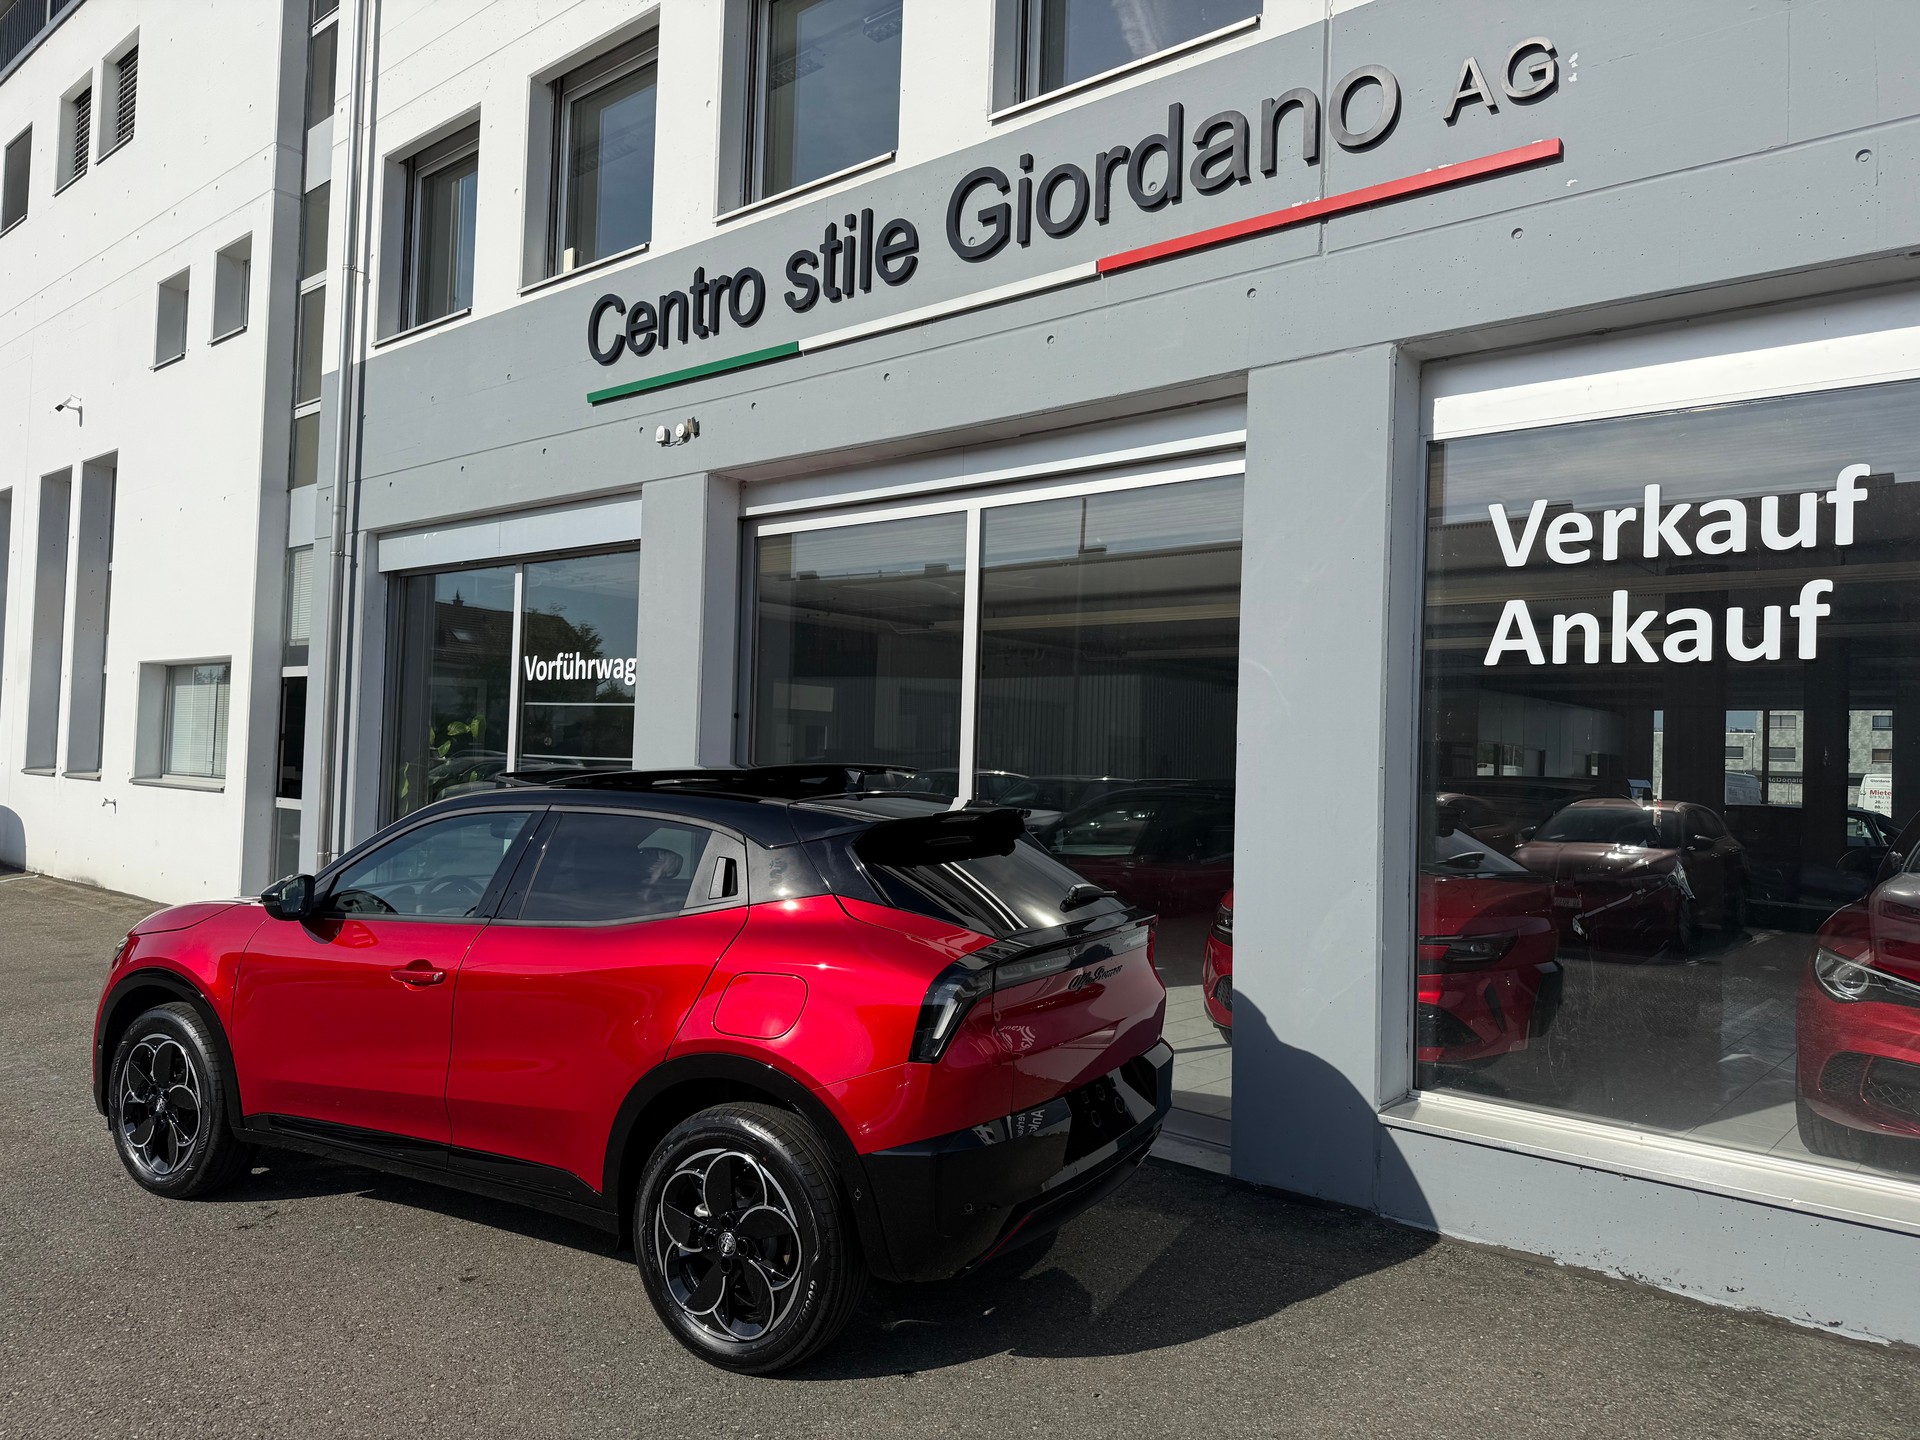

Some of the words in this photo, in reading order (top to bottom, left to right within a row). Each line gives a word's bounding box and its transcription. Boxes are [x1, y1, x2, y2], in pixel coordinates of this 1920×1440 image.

[587, 266, 766, 366] Centro
[783, 207, 920, 314] stile
[945, 63, 1401, 263] Giordano
[1443, 36, 1559, 126] AG
[1488, 463, 1871, 568] Verkauf
[524, 651, 637, 686] Vorführwag
[1483, 579, 1834, 666] Ankauf
